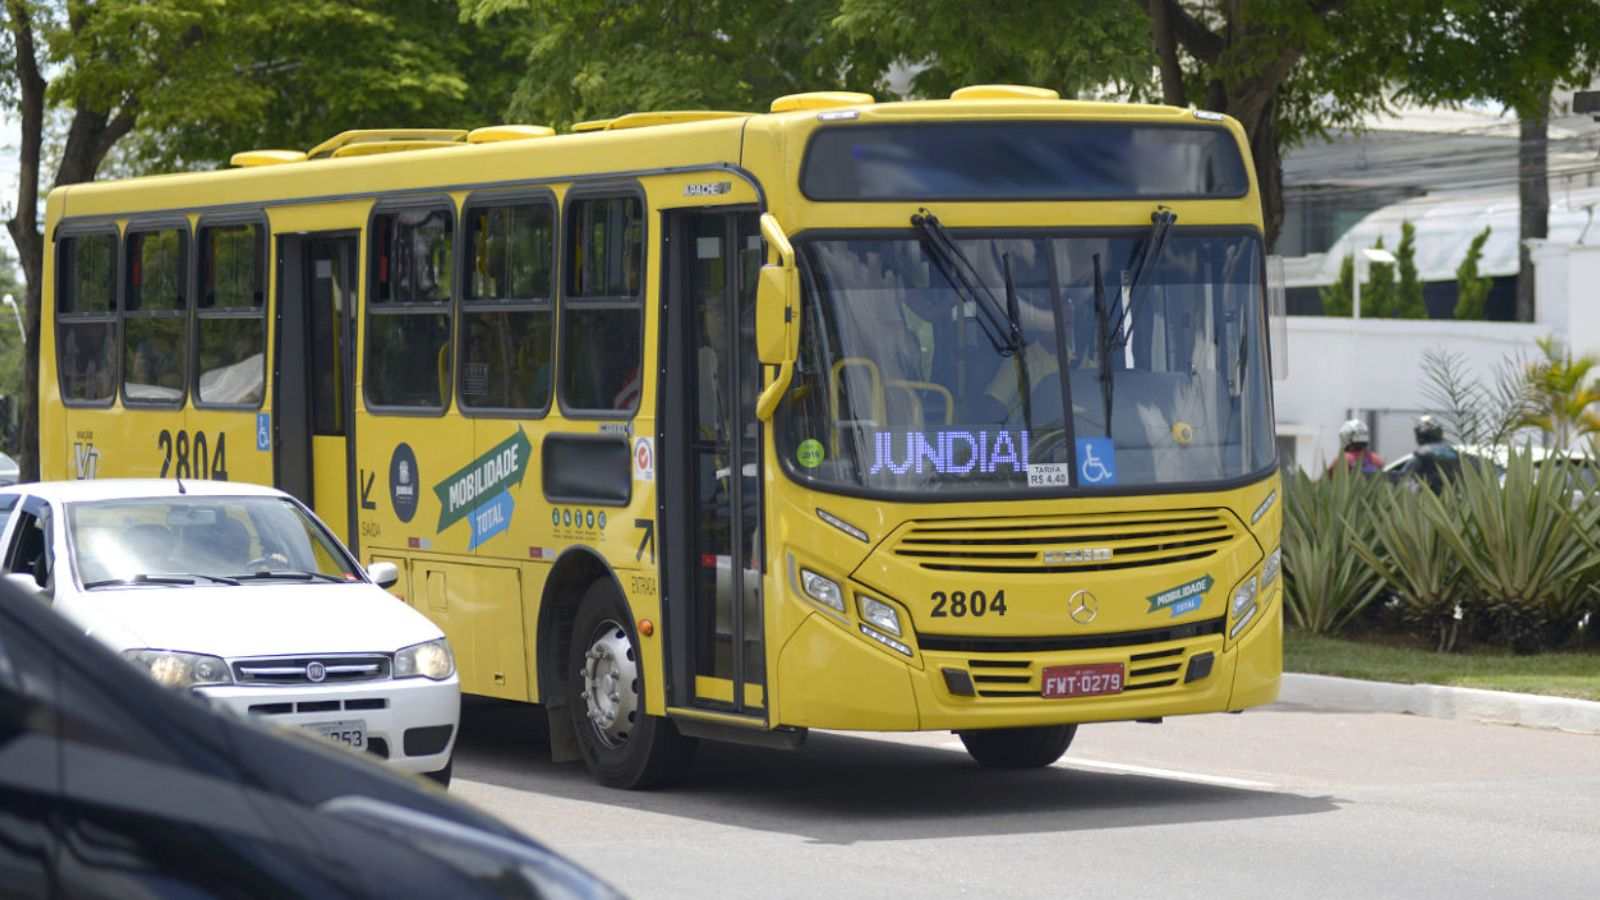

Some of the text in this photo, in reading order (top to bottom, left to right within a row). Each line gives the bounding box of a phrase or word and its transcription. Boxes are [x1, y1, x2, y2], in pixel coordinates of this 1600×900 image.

[159, 429, 228, 480] 2804
[449, 442, 519, 513] MOBILIDADE
[475, 504, 504, 537] TOTAL
[930, 590, 1007, 618] 2804
[1157, 579, 1207, 606] MOBILIDADE
